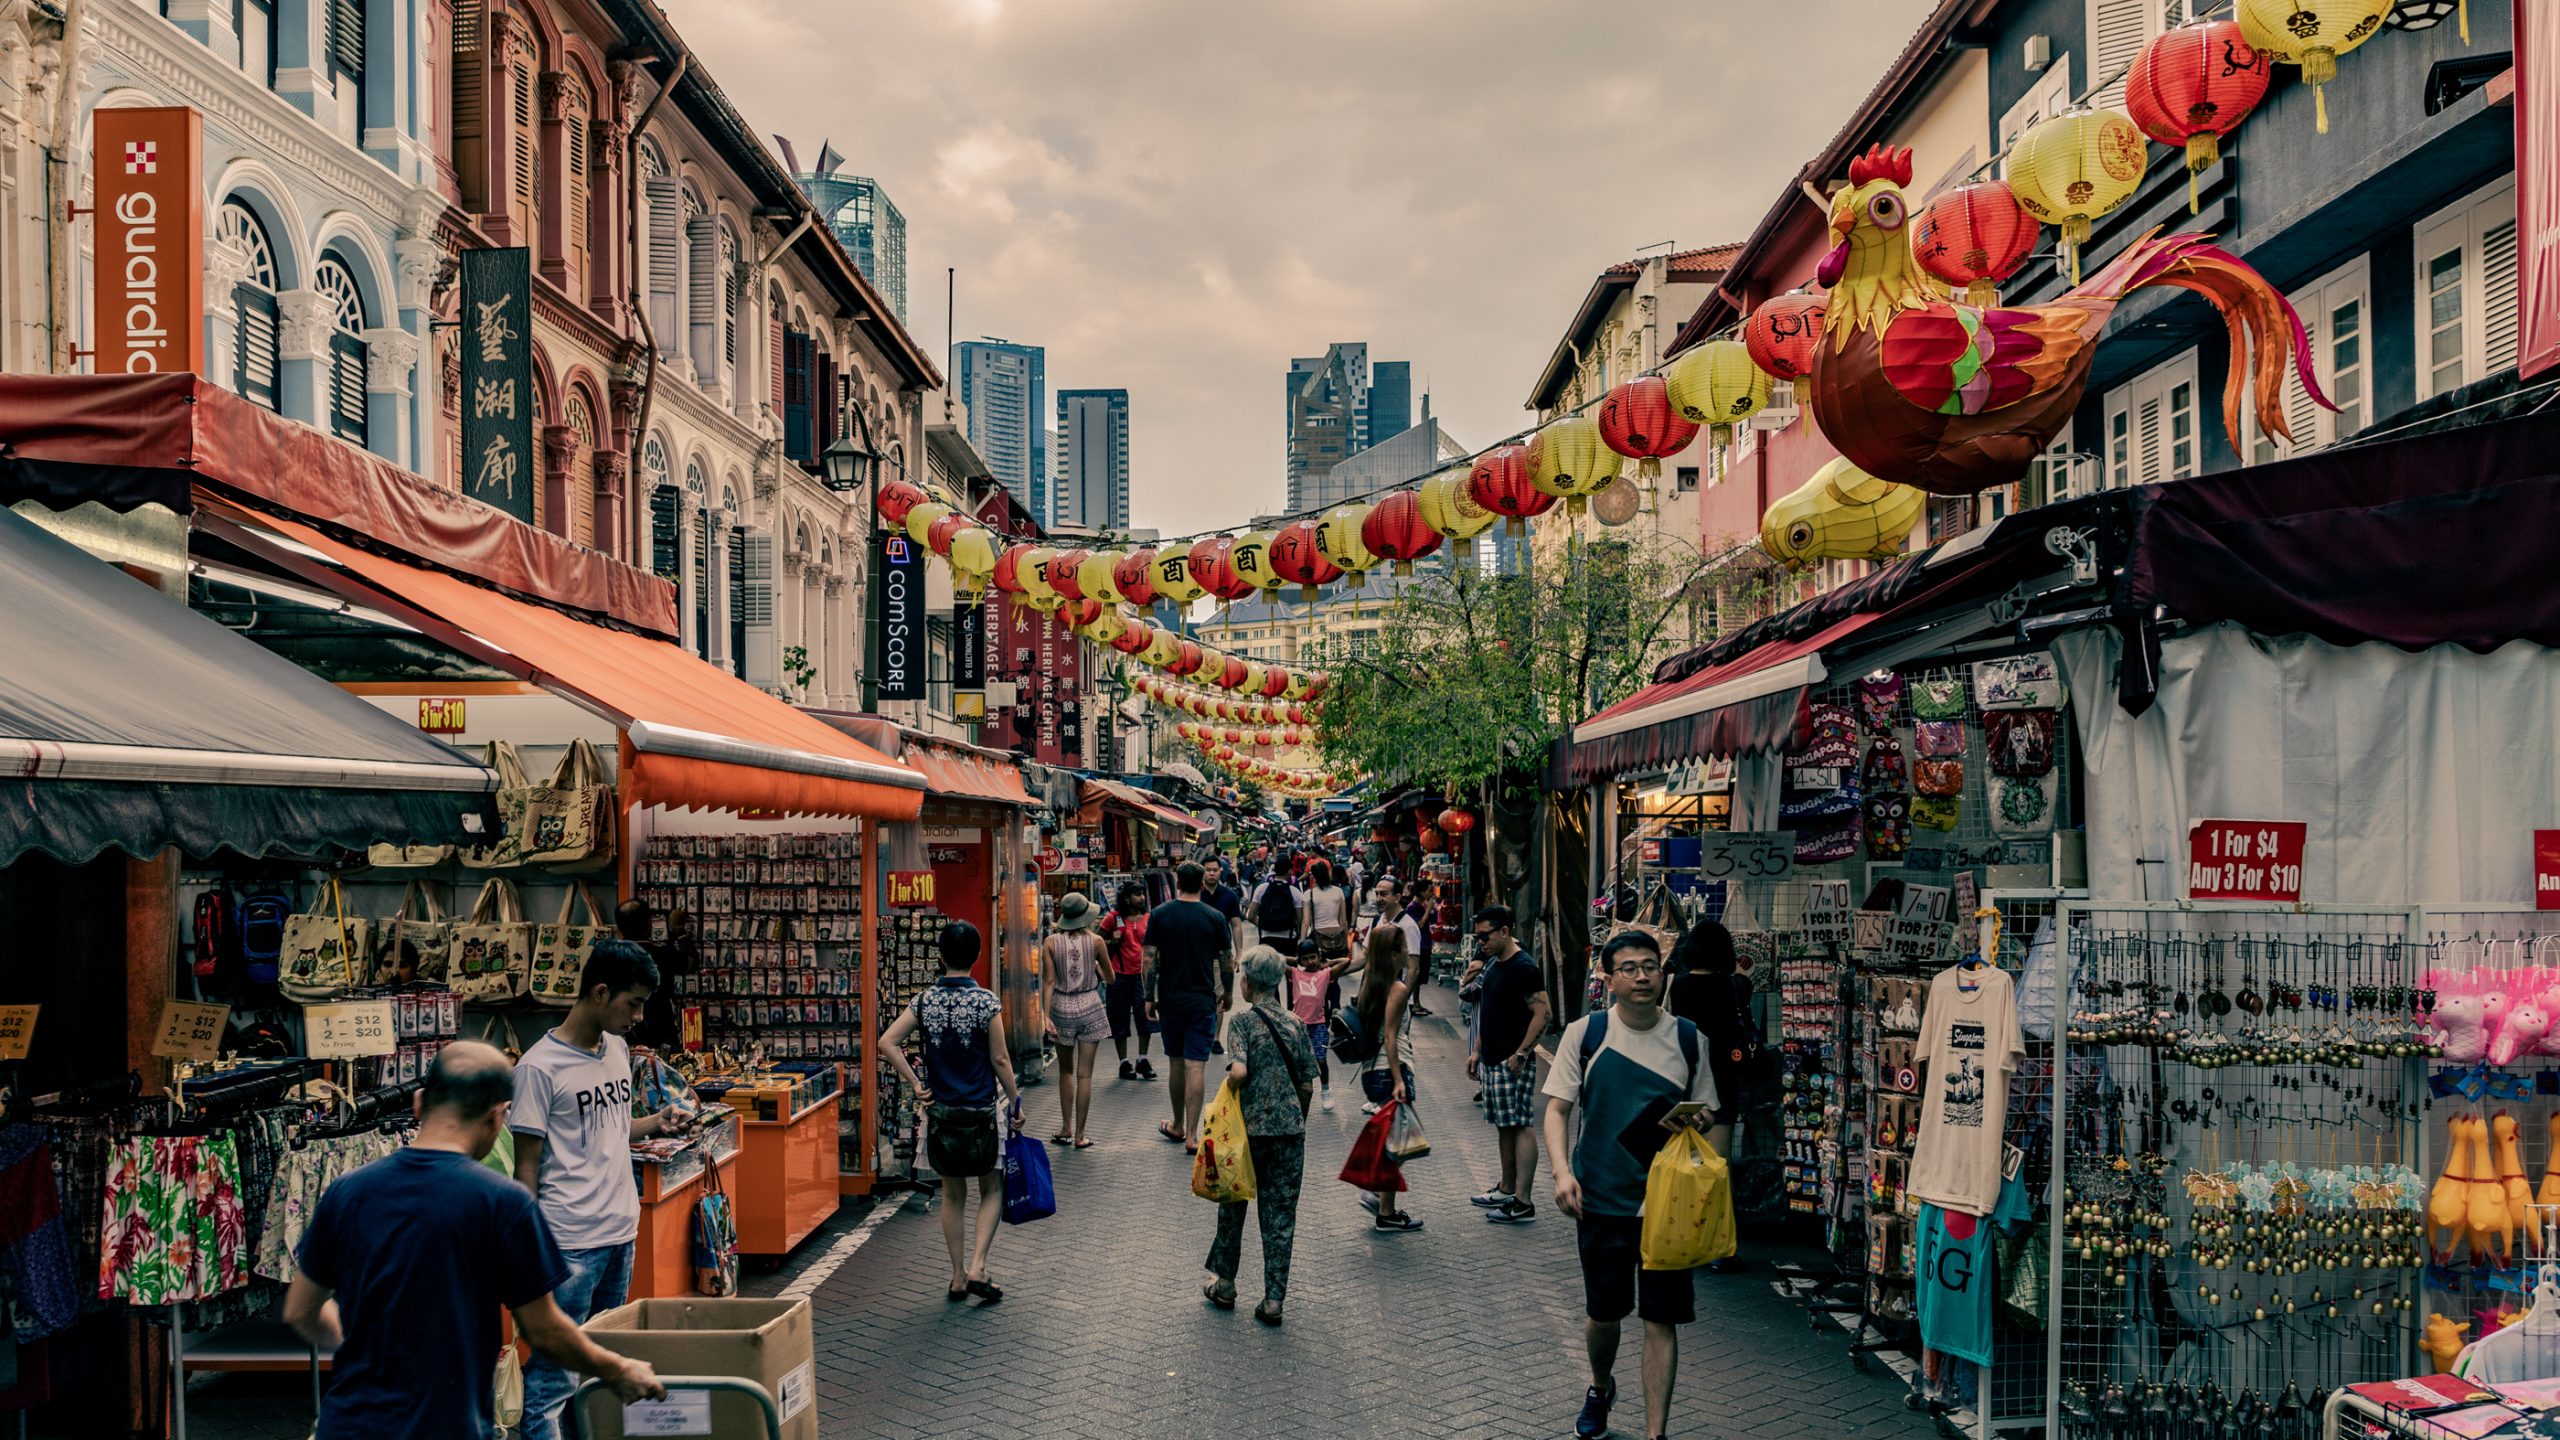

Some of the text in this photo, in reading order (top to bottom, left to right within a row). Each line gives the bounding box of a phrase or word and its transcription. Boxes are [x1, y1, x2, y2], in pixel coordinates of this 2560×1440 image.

[1042, 643, 1054, 699] HERITAGE
[420, 701, 429, 729] 3
[443, 701, 466, 730] $10
[1042, 701, 1054, 747] CENTRE
[2210, 828, 2279, 861] 1 For $4
[1706, 847, 1735, 877] 3
[1747, 846, 1789, 877] $5
[897, 882, 912, 902] for
[912, 873, 935, 902] $10
[2190, 861, 2300, 895] Any 3 For $10
[1811, 884, 1824, 910] 7
[1904, 887, 1923, 918] 7
[1801, 912, 1807, 926] 1
[1810, 911, 1832, 926] FOR
[1833, 910, 1848, 925] $2
[1889, 918, 1939, 939] 1 FOR $2
[1802, 928, 1809, 943] 3
[1811, 928, 1834, 942] FOR
[1835, 927, 1850, 941] $5
[1884, 936, 1936, 957] 3 FOR $5
[1, 1017, 23, 1027] $12
[173, 1013, 217, 1028] 1 $12
[323, 1014, 381, 1027] 1 $12
[168, 1027, 213, 1042] 2 $20
[319, 1040, 356, 1049] No Trying
[324, 1027, 382, 1040] 2 $20
[575, 1078, 632, 1116] PARIS
